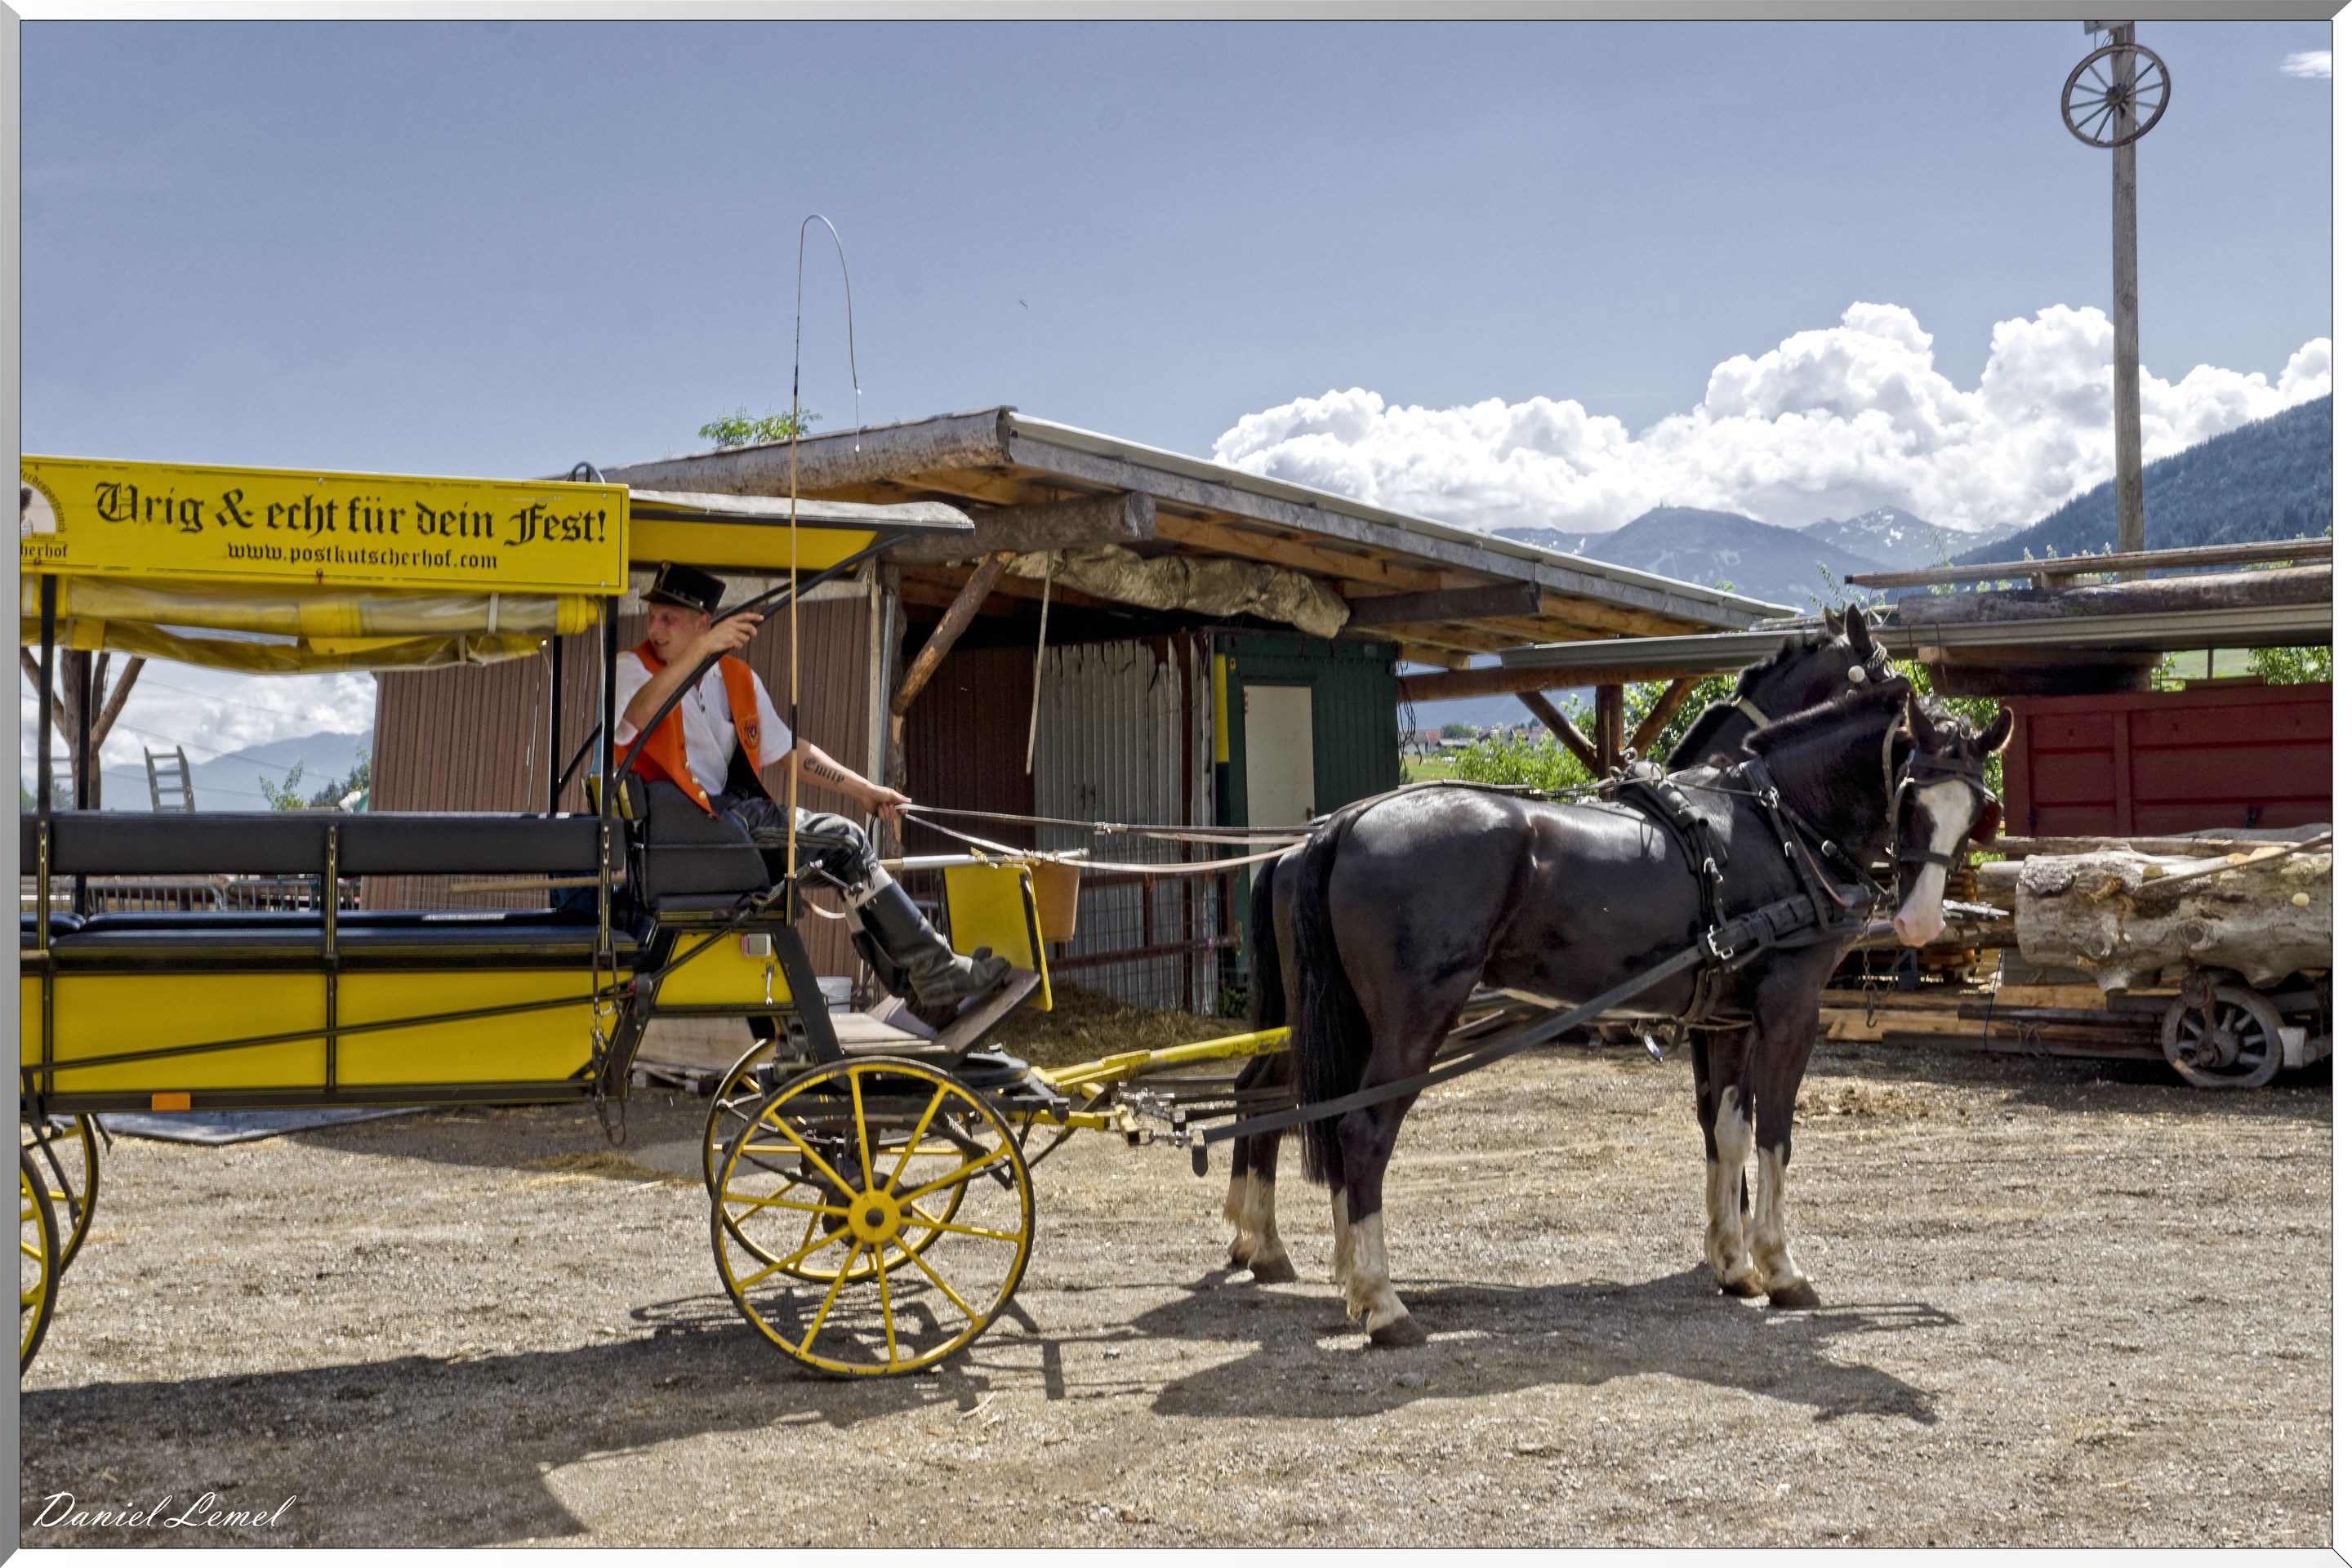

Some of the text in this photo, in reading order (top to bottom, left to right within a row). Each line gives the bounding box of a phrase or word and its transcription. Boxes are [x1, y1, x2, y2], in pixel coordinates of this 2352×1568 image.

[95, 481, 607, 548] Urig & echt für dein Fest!
[228, 541, 497, 569] www.postkutscherhof.com
[803, 756, 845, 783] Emily
